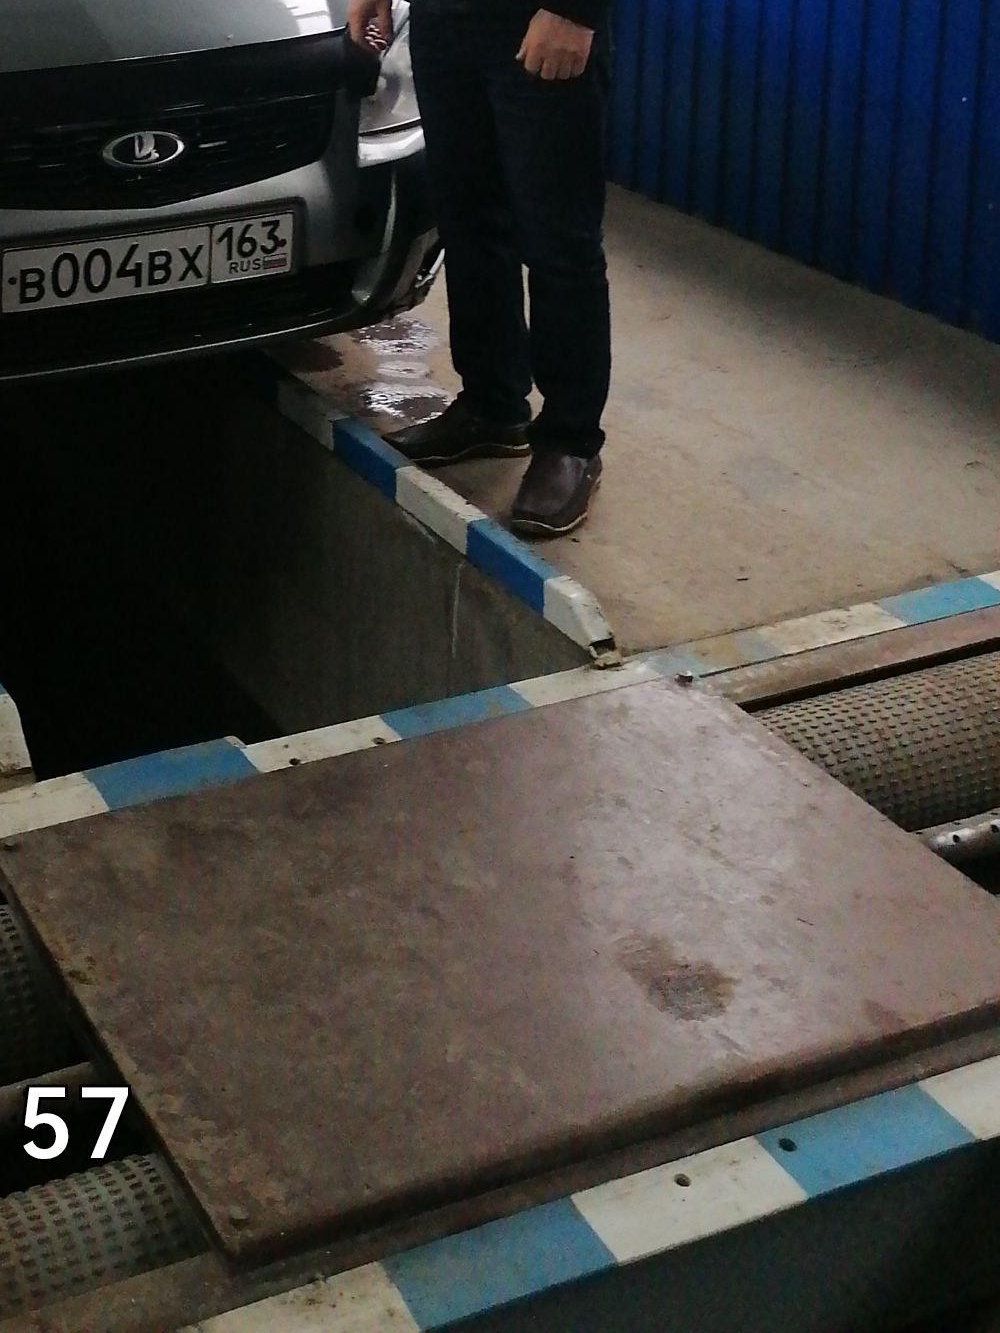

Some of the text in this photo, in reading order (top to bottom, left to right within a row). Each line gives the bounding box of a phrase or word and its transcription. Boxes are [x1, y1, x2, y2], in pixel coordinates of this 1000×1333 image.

[18, 219, 281, 305] В004ВХ 163
[228, 258, 262, 275] RUS
